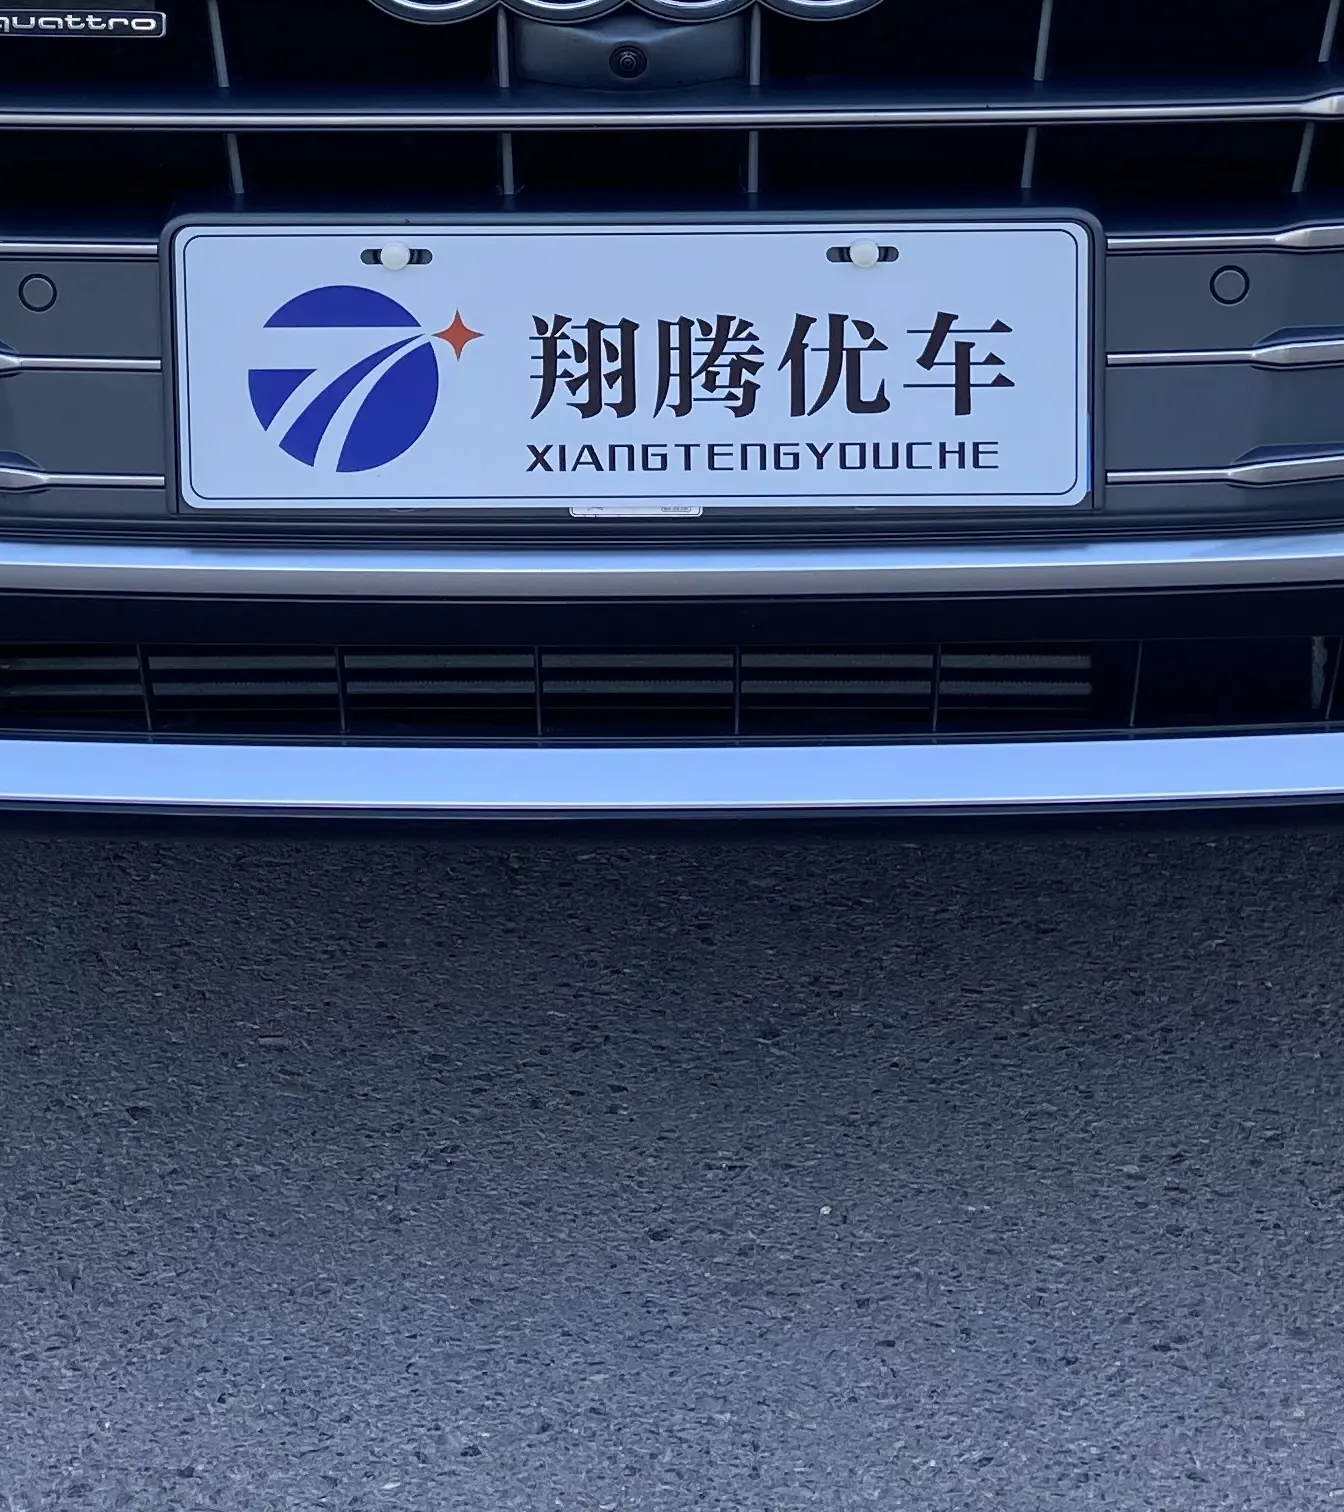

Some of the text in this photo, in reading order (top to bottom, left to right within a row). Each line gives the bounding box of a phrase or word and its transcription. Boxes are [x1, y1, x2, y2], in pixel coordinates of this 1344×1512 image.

[529, 311, 1017, 420] 翔腾优车
[525, 440, 1001, 472] XIANGTENGYOUCHE
